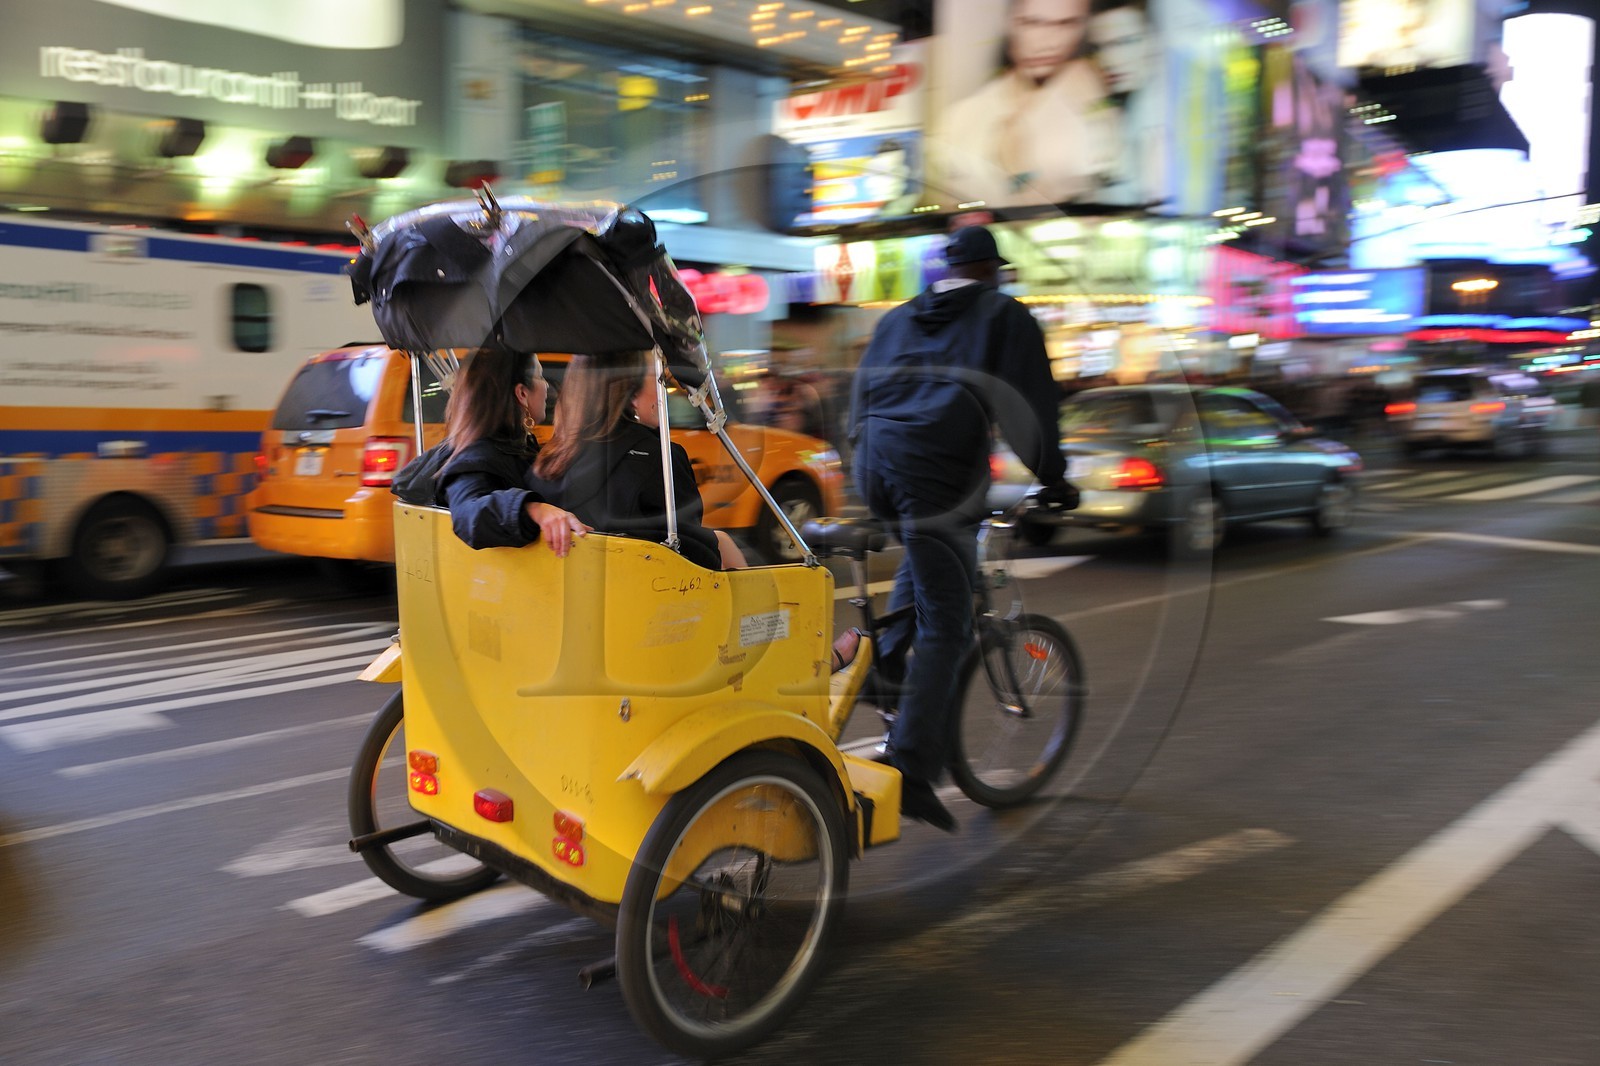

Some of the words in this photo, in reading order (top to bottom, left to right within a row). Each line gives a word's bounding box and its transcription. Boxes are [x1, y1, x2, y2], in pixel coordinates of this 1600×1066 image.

[40, 46, 302, 109] restaurant
[336, 81, 421, 126] bar
[651, 576, 701, 596] C-462
